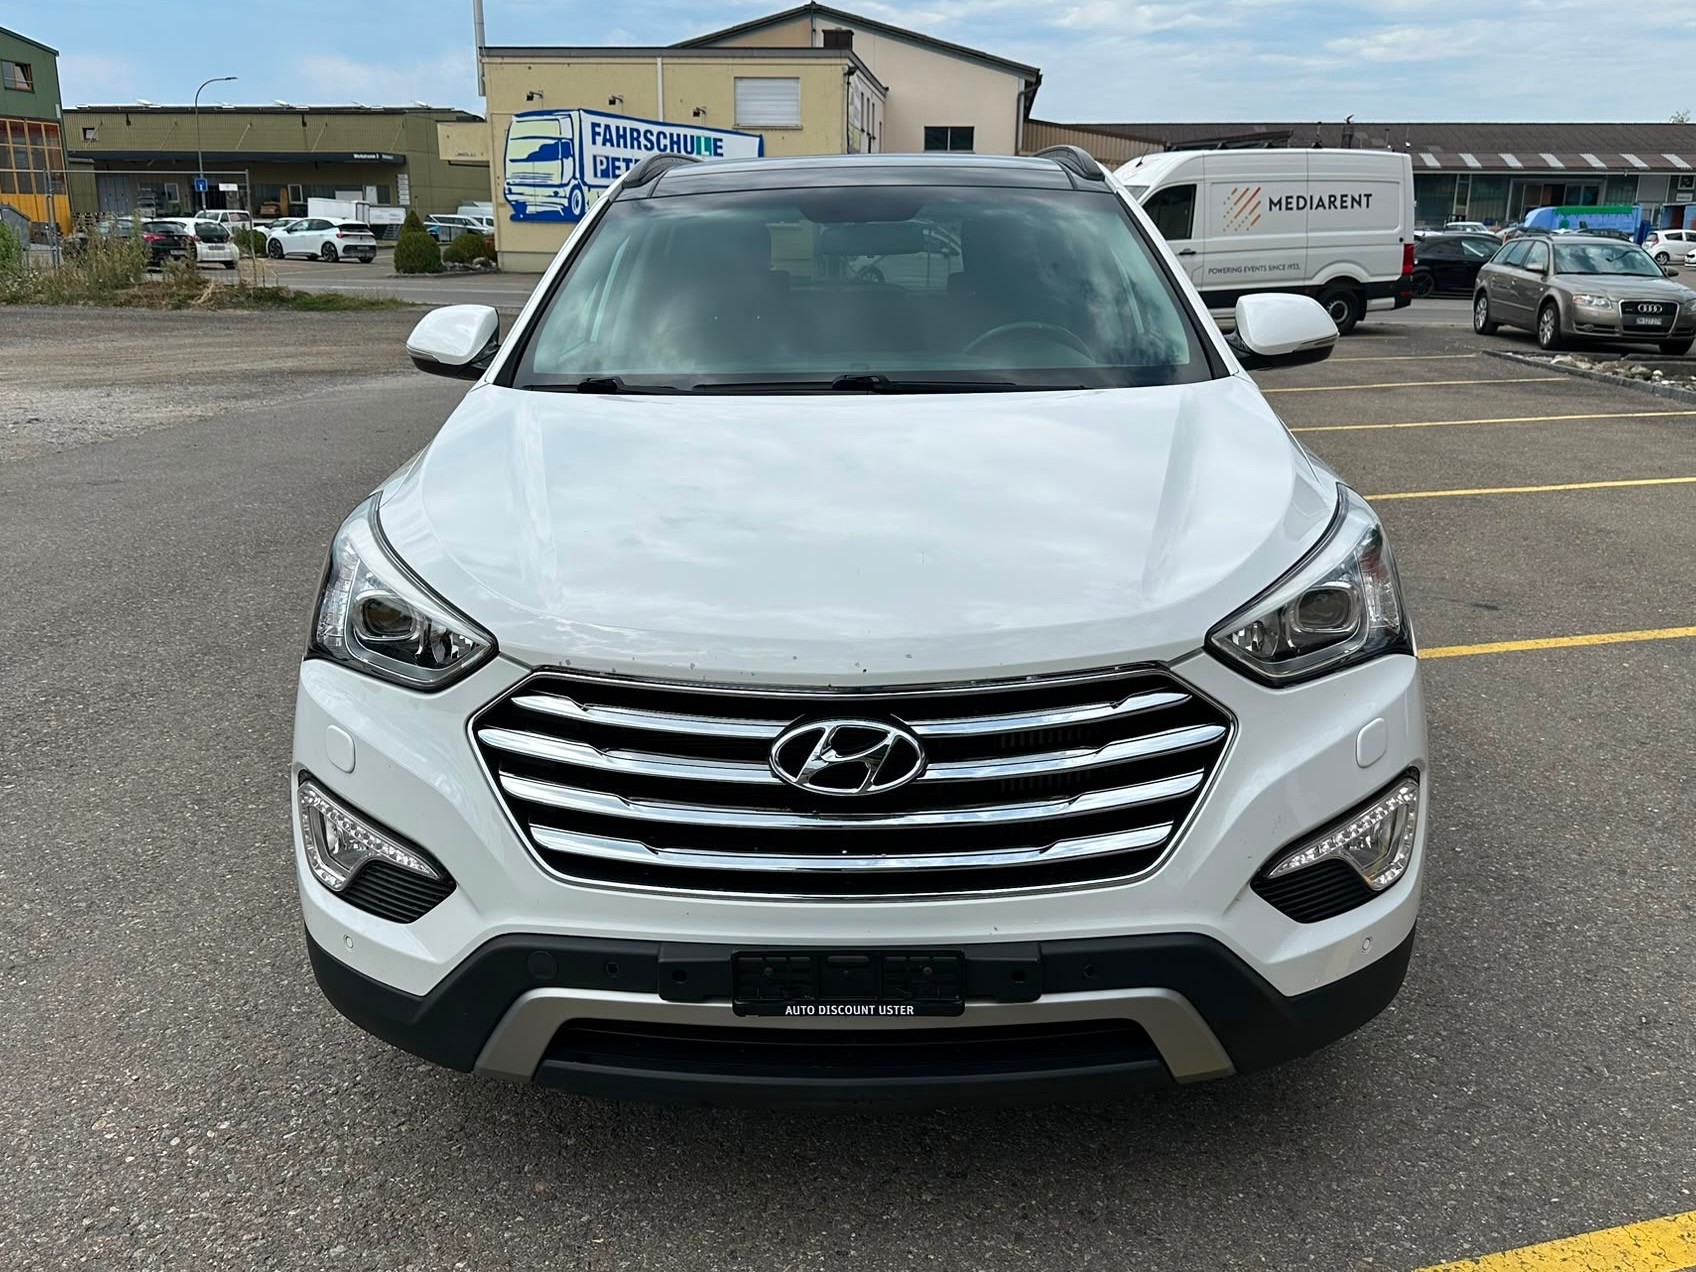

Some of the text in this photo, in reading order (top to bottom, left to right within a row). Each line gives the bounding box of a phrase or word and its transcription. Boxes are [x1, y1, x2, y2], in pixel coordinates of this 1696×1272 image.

[591, 122, 723, 157] FAHRSCHULE
[593, 155, 641, 179] PET
[1268, 193, 1373, 212] MEDIARENT
[1208, 266, 1242, 275] POWERING
[1243, 265, 1267, 273] EVENTS
[1268, 263, 1286, 272] SINCE
[785, 1005, 914, 1015] AUTO DISCOUNT USTER
